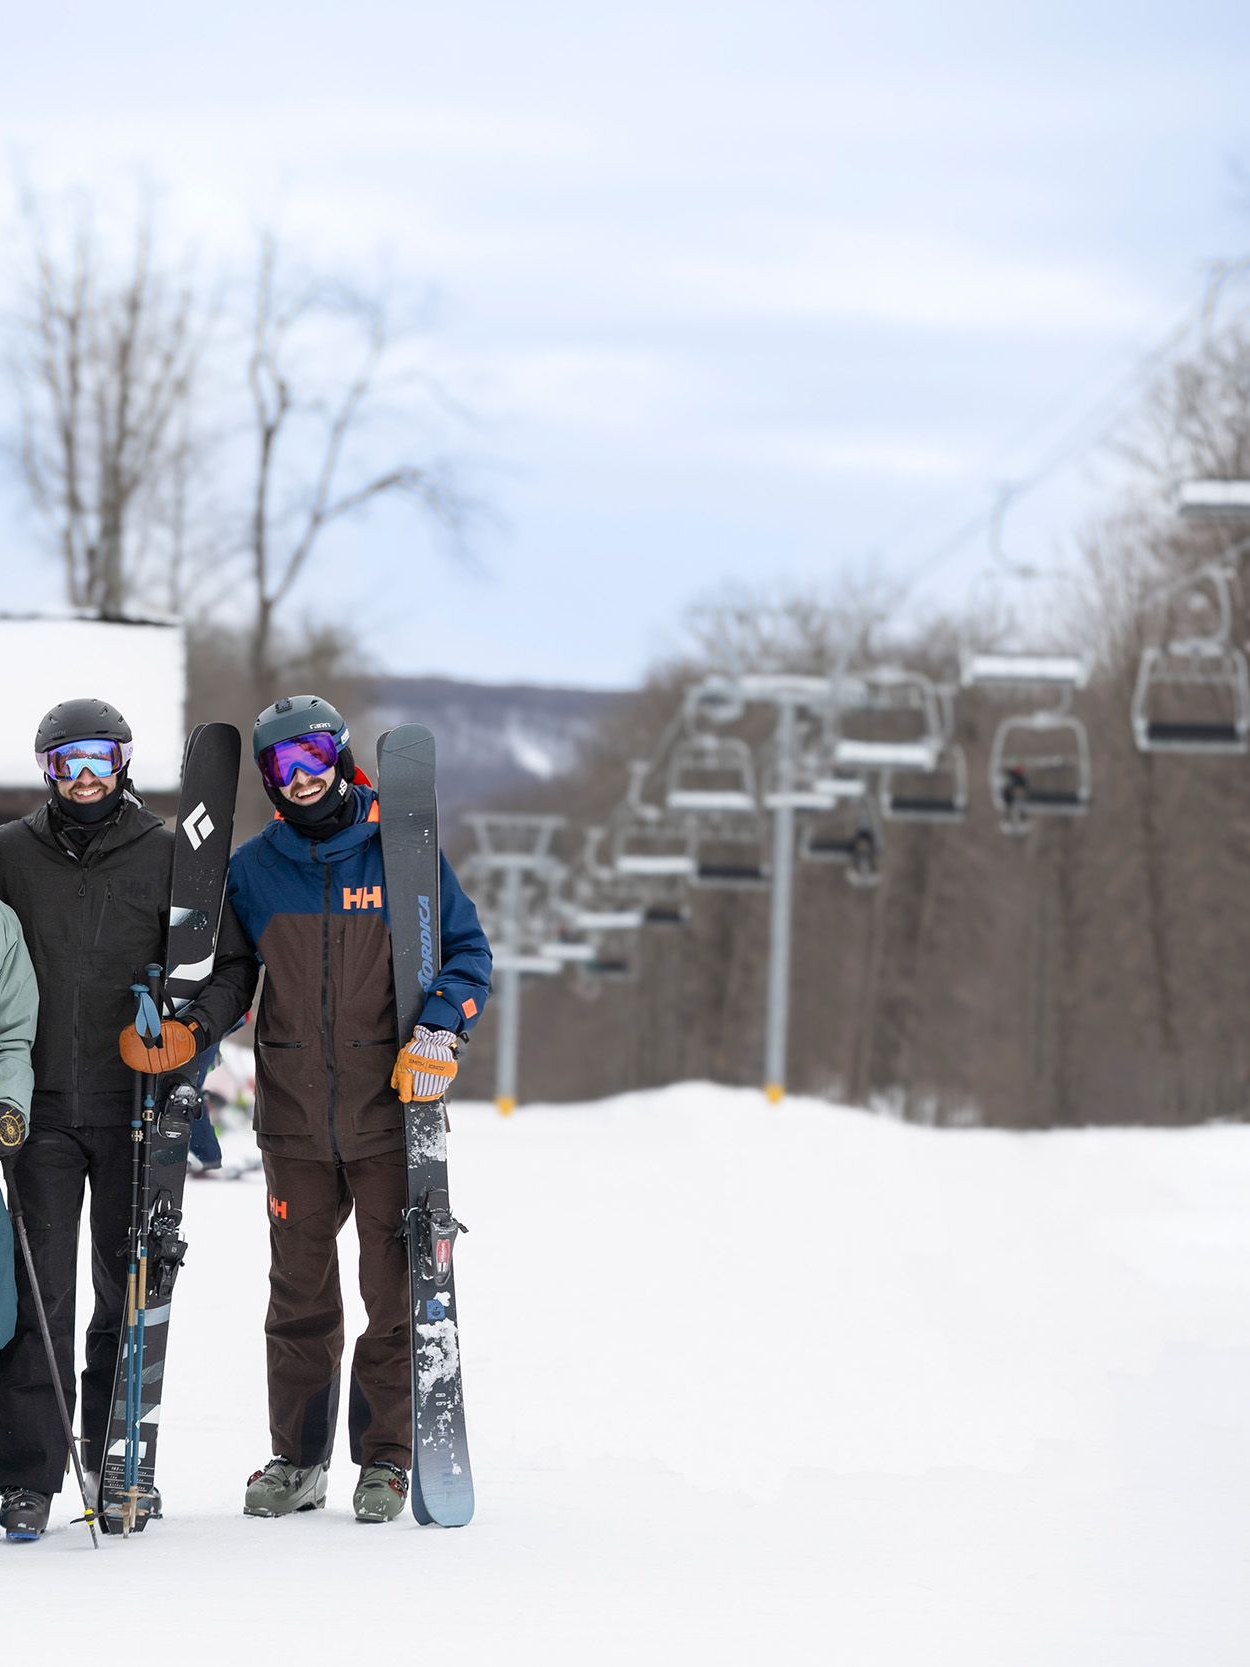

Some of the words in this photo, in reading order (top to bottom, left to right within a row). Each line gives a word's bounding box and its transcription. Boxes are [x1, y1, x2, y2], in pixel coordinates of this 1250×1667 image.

[343, 886, 383, 910] HH
[417, 895, 434, 992] NORDICA
[269, 1193, 288, 1220] HH
